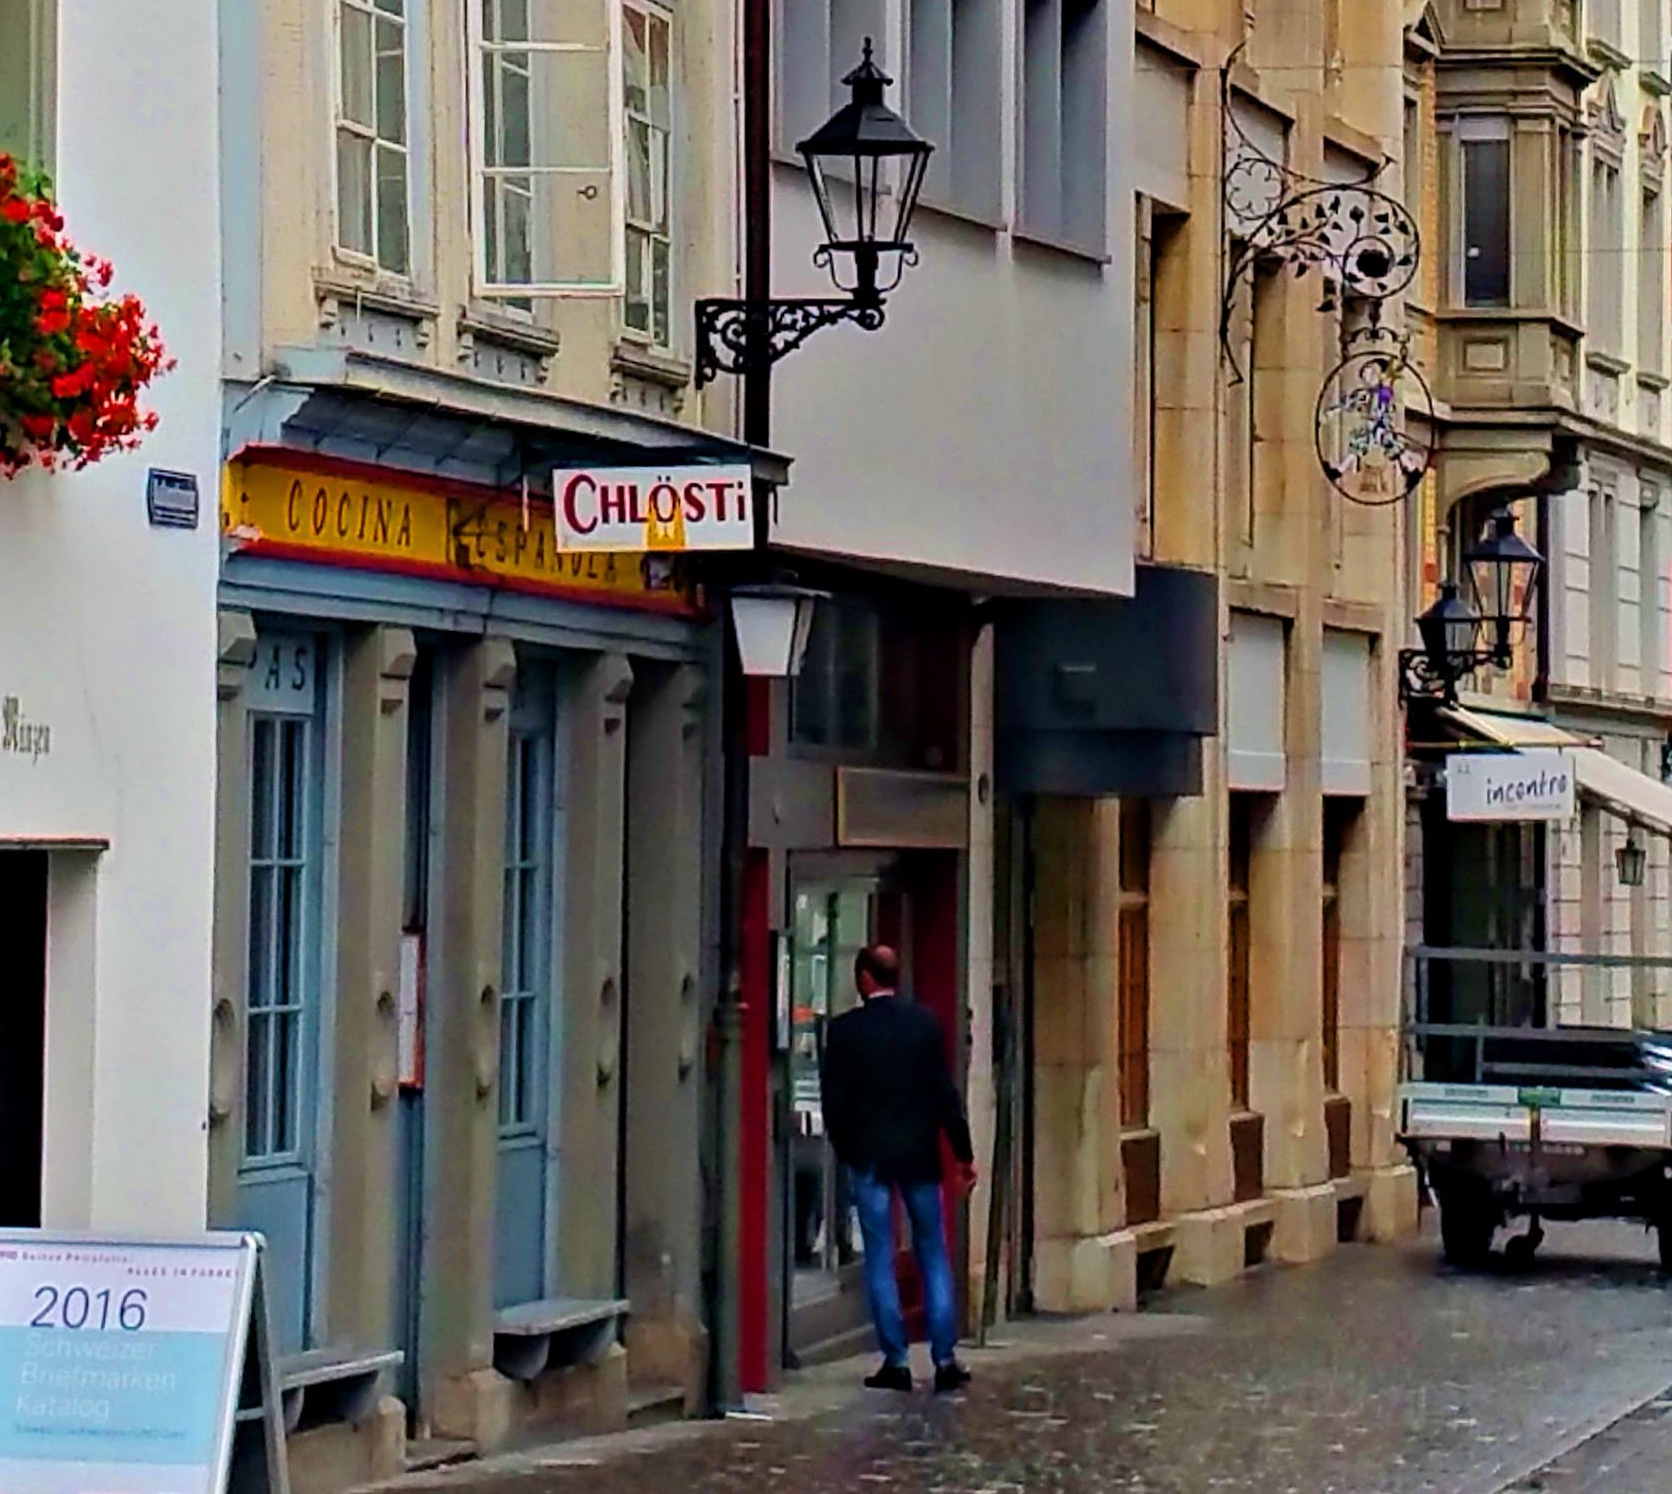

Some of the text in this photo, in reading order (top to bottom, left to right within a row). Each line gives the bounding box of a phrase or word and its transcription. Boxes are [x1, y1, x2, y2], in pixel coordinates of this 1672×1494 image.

[287, 479, 412, 548] COCINA
[1486, 769, 1567, 805] incontro
[30, 1285, 148, 1331] 2016
[23, 1331, 160, 1362] Schweizer
[20, 1360, 177, 1391] Briefmarken
[15, 1392, 111, 1424] Katalog
